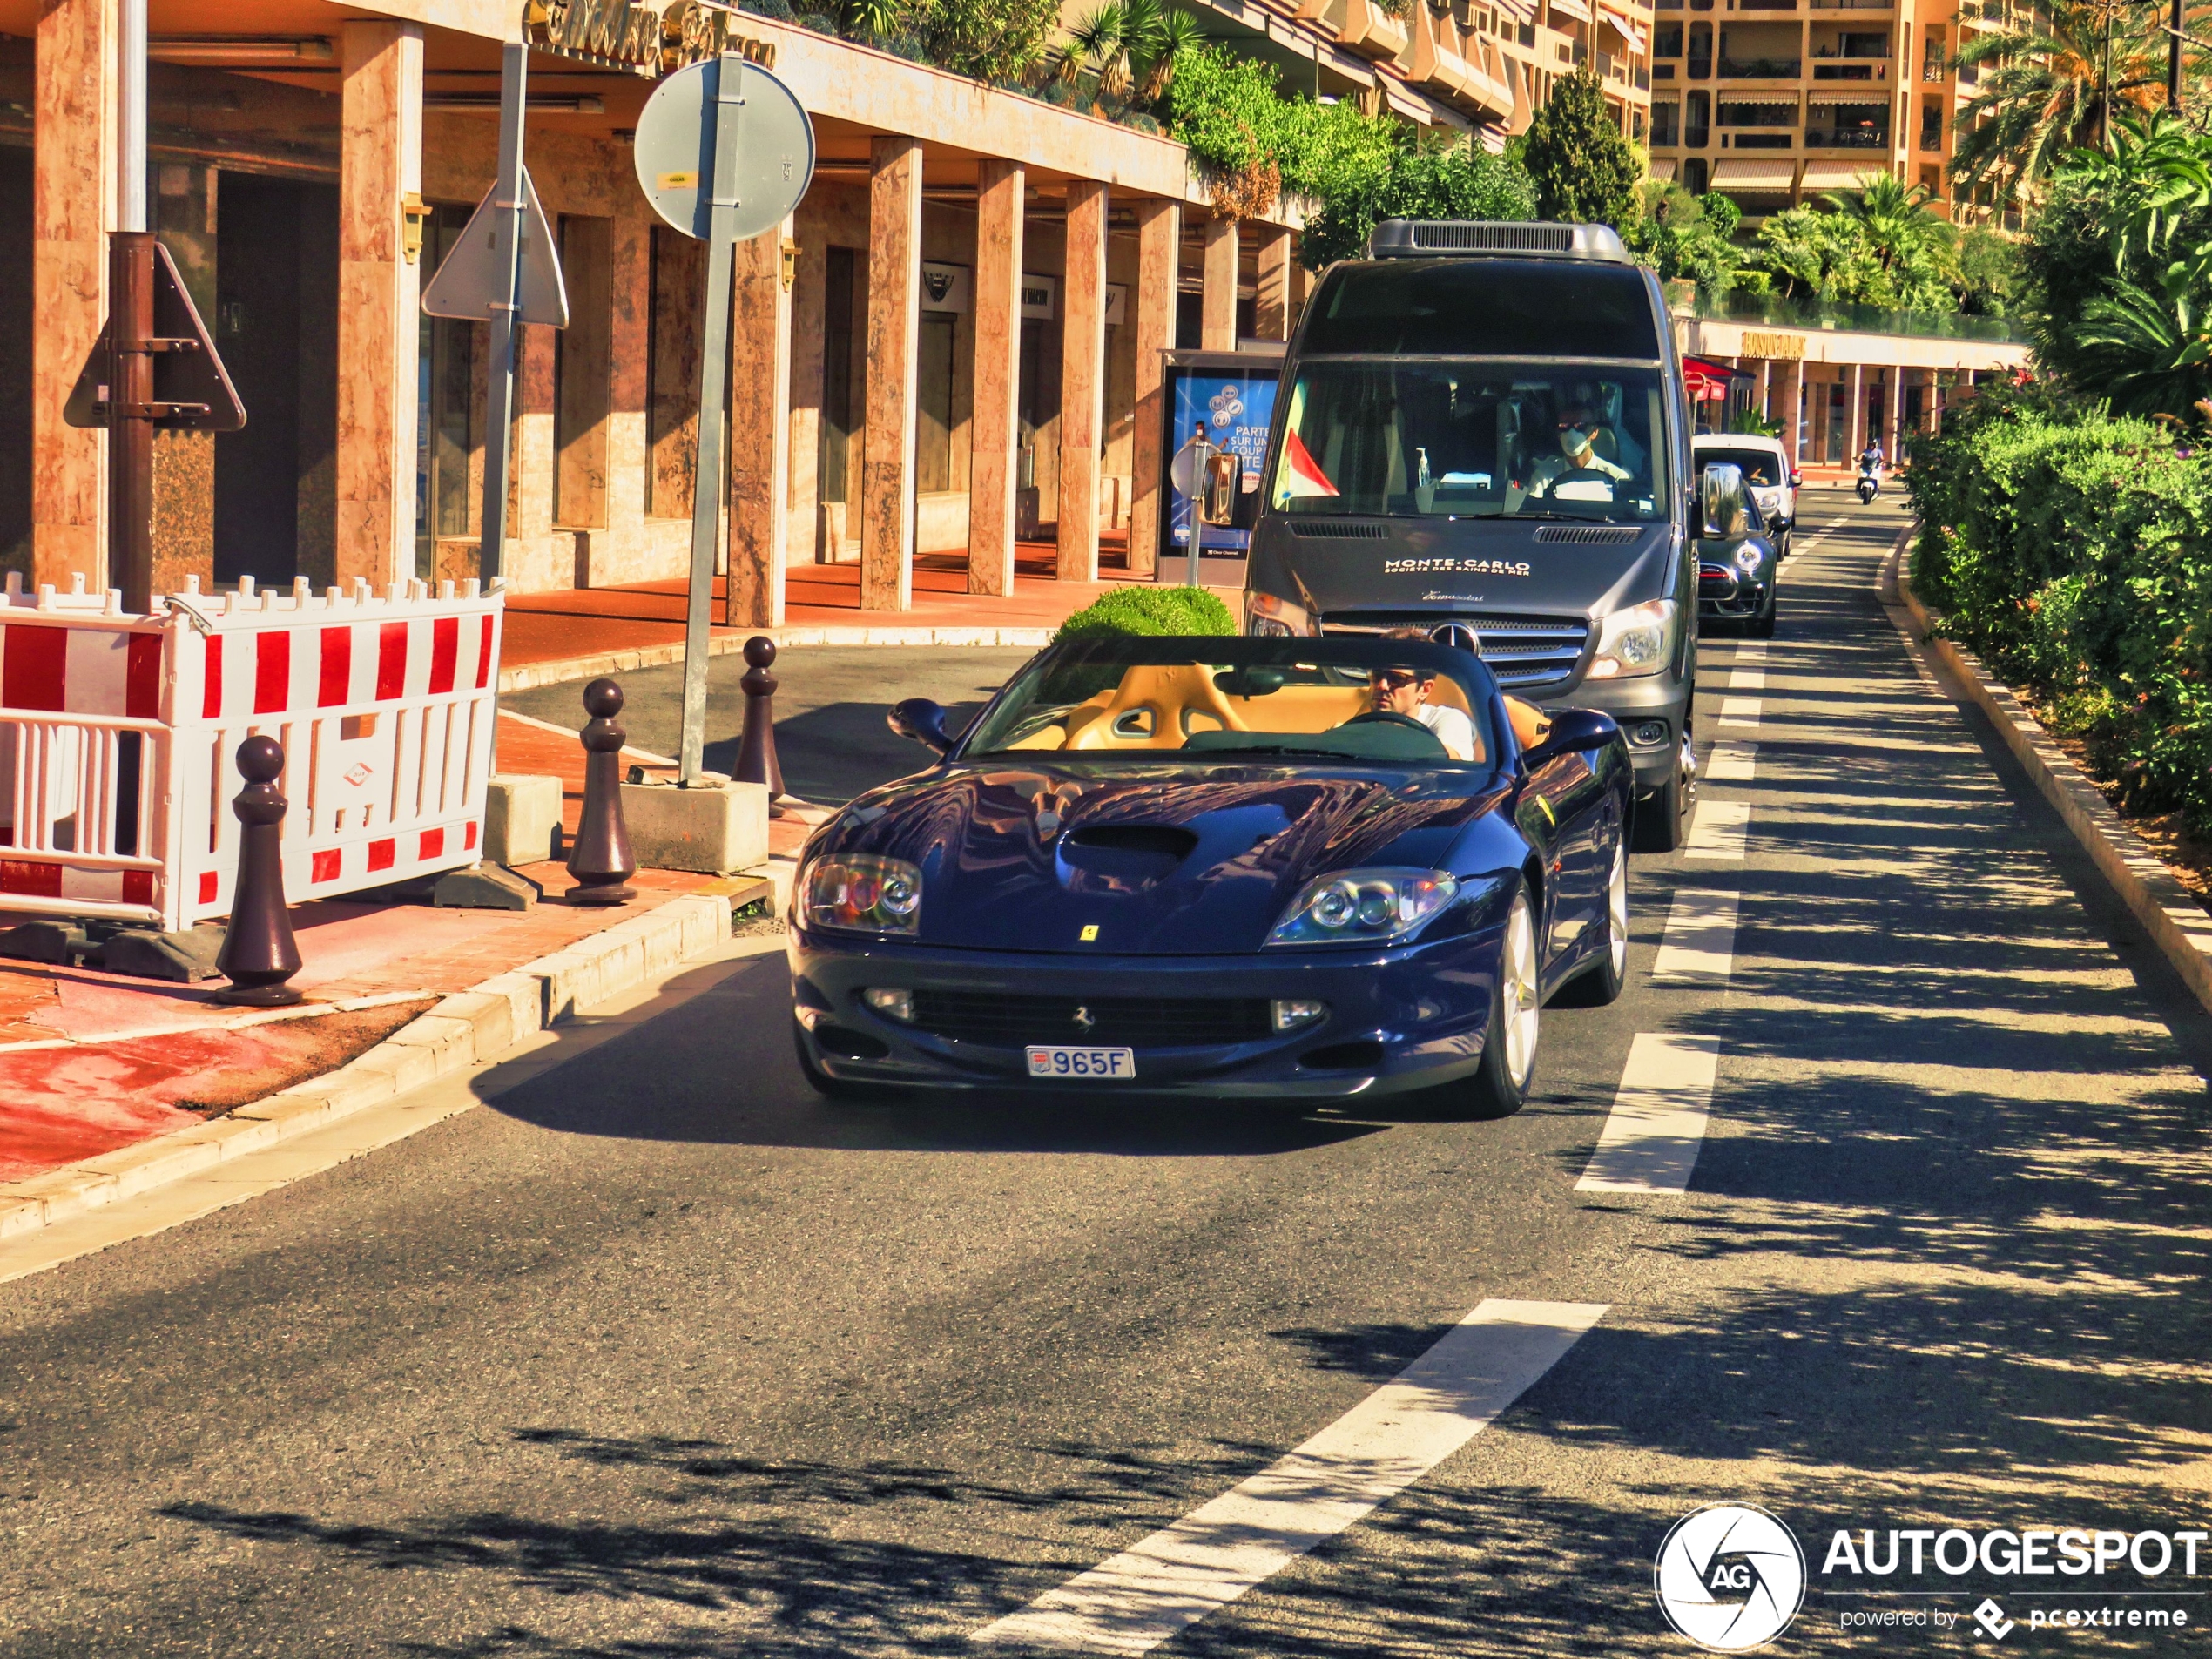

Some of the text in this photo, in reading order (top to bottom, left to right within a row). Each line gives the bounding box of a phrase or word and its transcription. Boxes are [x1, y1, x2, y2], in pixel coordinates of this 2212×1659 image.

[1231, 436, 1251, 446] SUR
[1231, 446, 1262, 455] COUP
[1053, 1051, 1124, 1075] 965F
